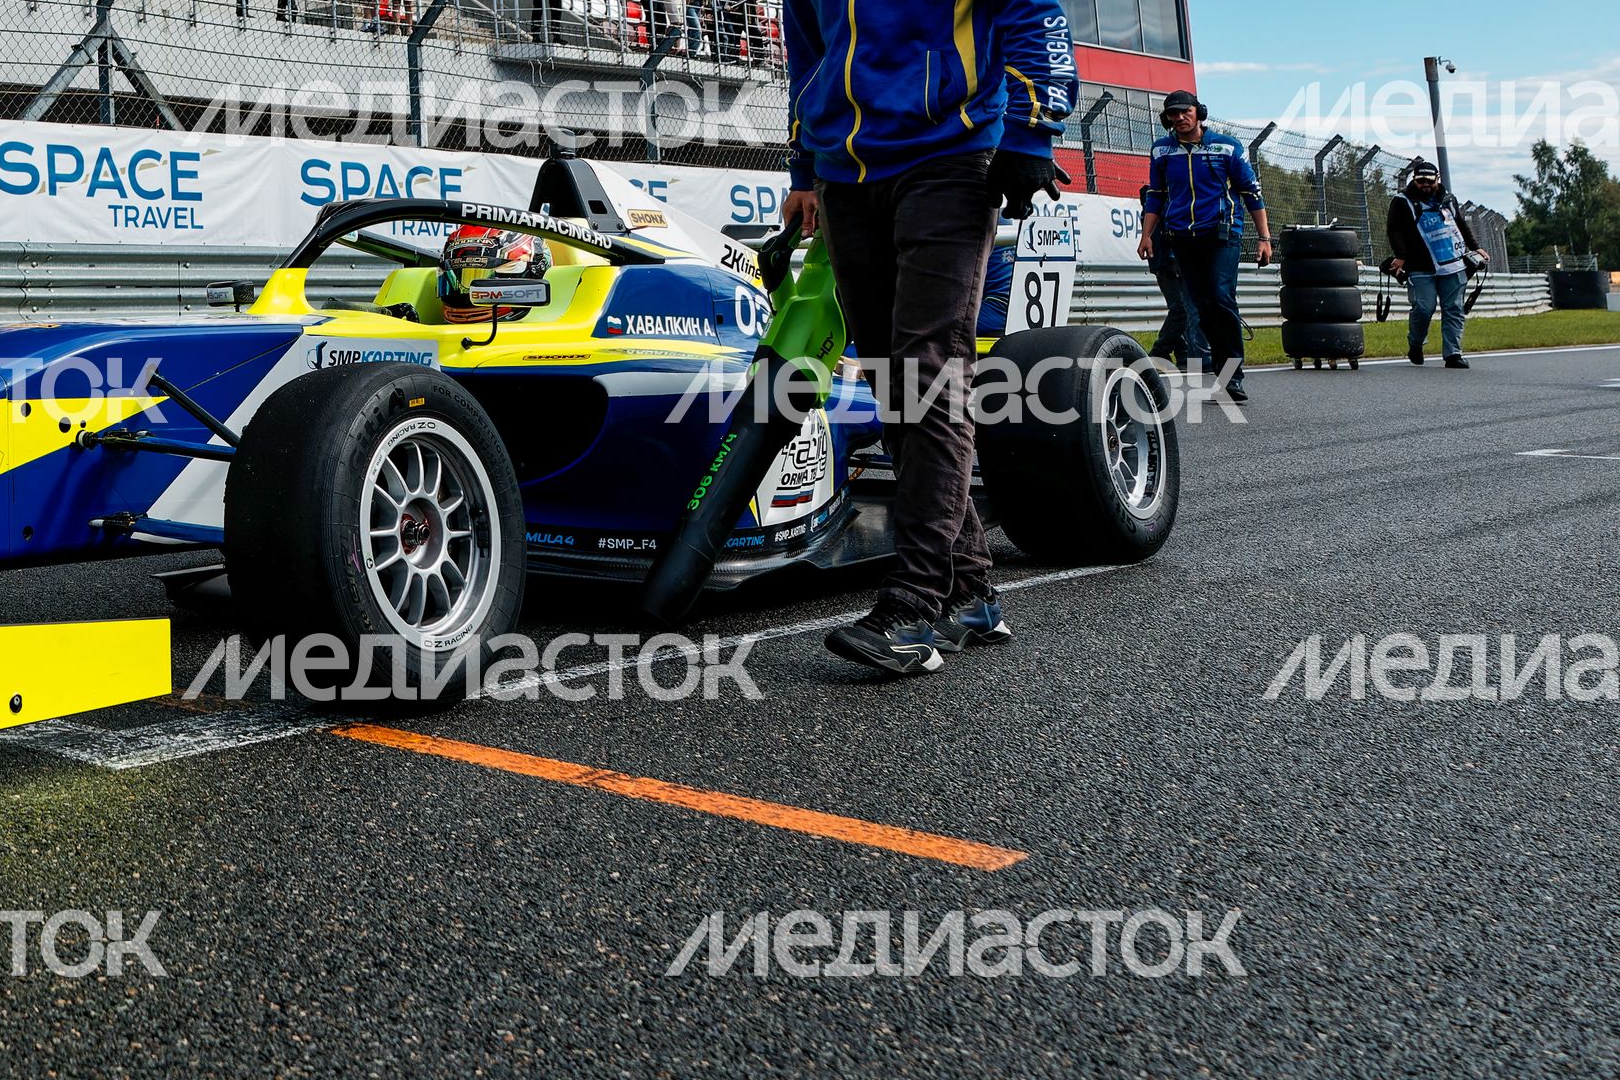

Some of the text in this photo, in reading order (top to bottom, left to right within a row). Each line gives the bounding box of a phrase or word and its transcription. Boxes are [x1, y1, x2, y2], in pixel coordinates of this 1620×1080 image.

[300, 157, 464, 207] SPACE
[108, 203, 205, 230] TRAVEL
[460, 202, 613, 250] PRIMARACING.RU
[630, 210, 667, 226] SHONX
[390, 218, 457, 237] TRAVE
[720, 243, 762, 280] 2Kline
[208, 290, 230, 300] SOFT
[471, 288, 543, 300] BPMSOFT
[1024, 271, 1060, 330] 87
[625, 314, 702, 336] ХАВАЛКИН
[433, 385, 452, 398] FOR
[387, 423, 416, 448] RACING
[724, 534, 765, 548] KARTING
[774, 523, 807, 543] #SMP_KARTING
[597, 537, 657, 551] #SMP_F4
[444, 623, 474, 647] RACING
